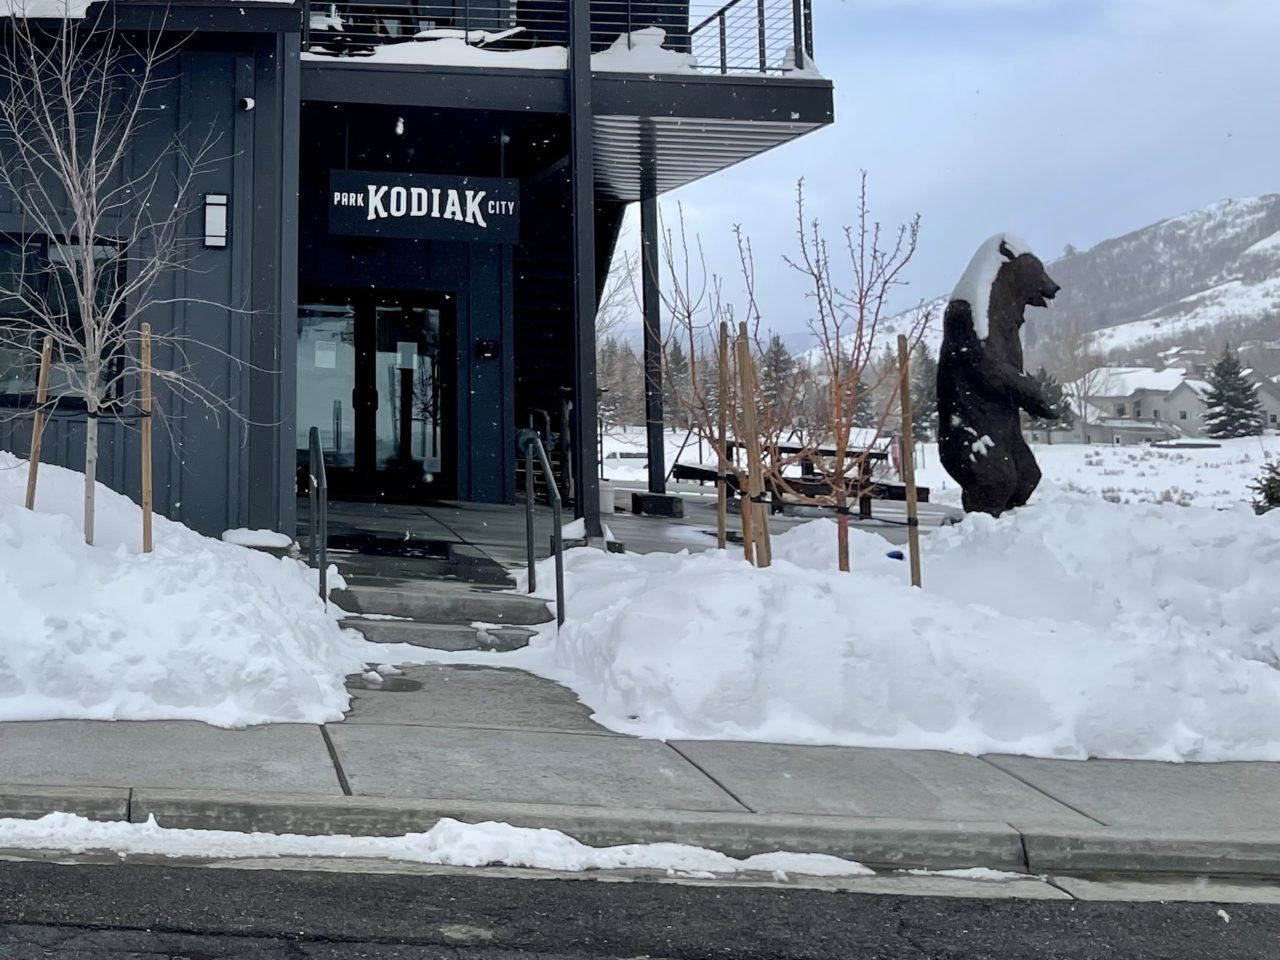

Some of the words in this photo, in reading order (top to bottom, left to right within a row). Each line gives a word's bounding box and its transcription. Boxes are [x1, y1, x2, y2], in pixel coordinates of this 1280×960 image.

[333, 192, 364, 207] PARK
[367, 185, 487, 228] KODIAK
[488, 200, 515, 215] CITY
